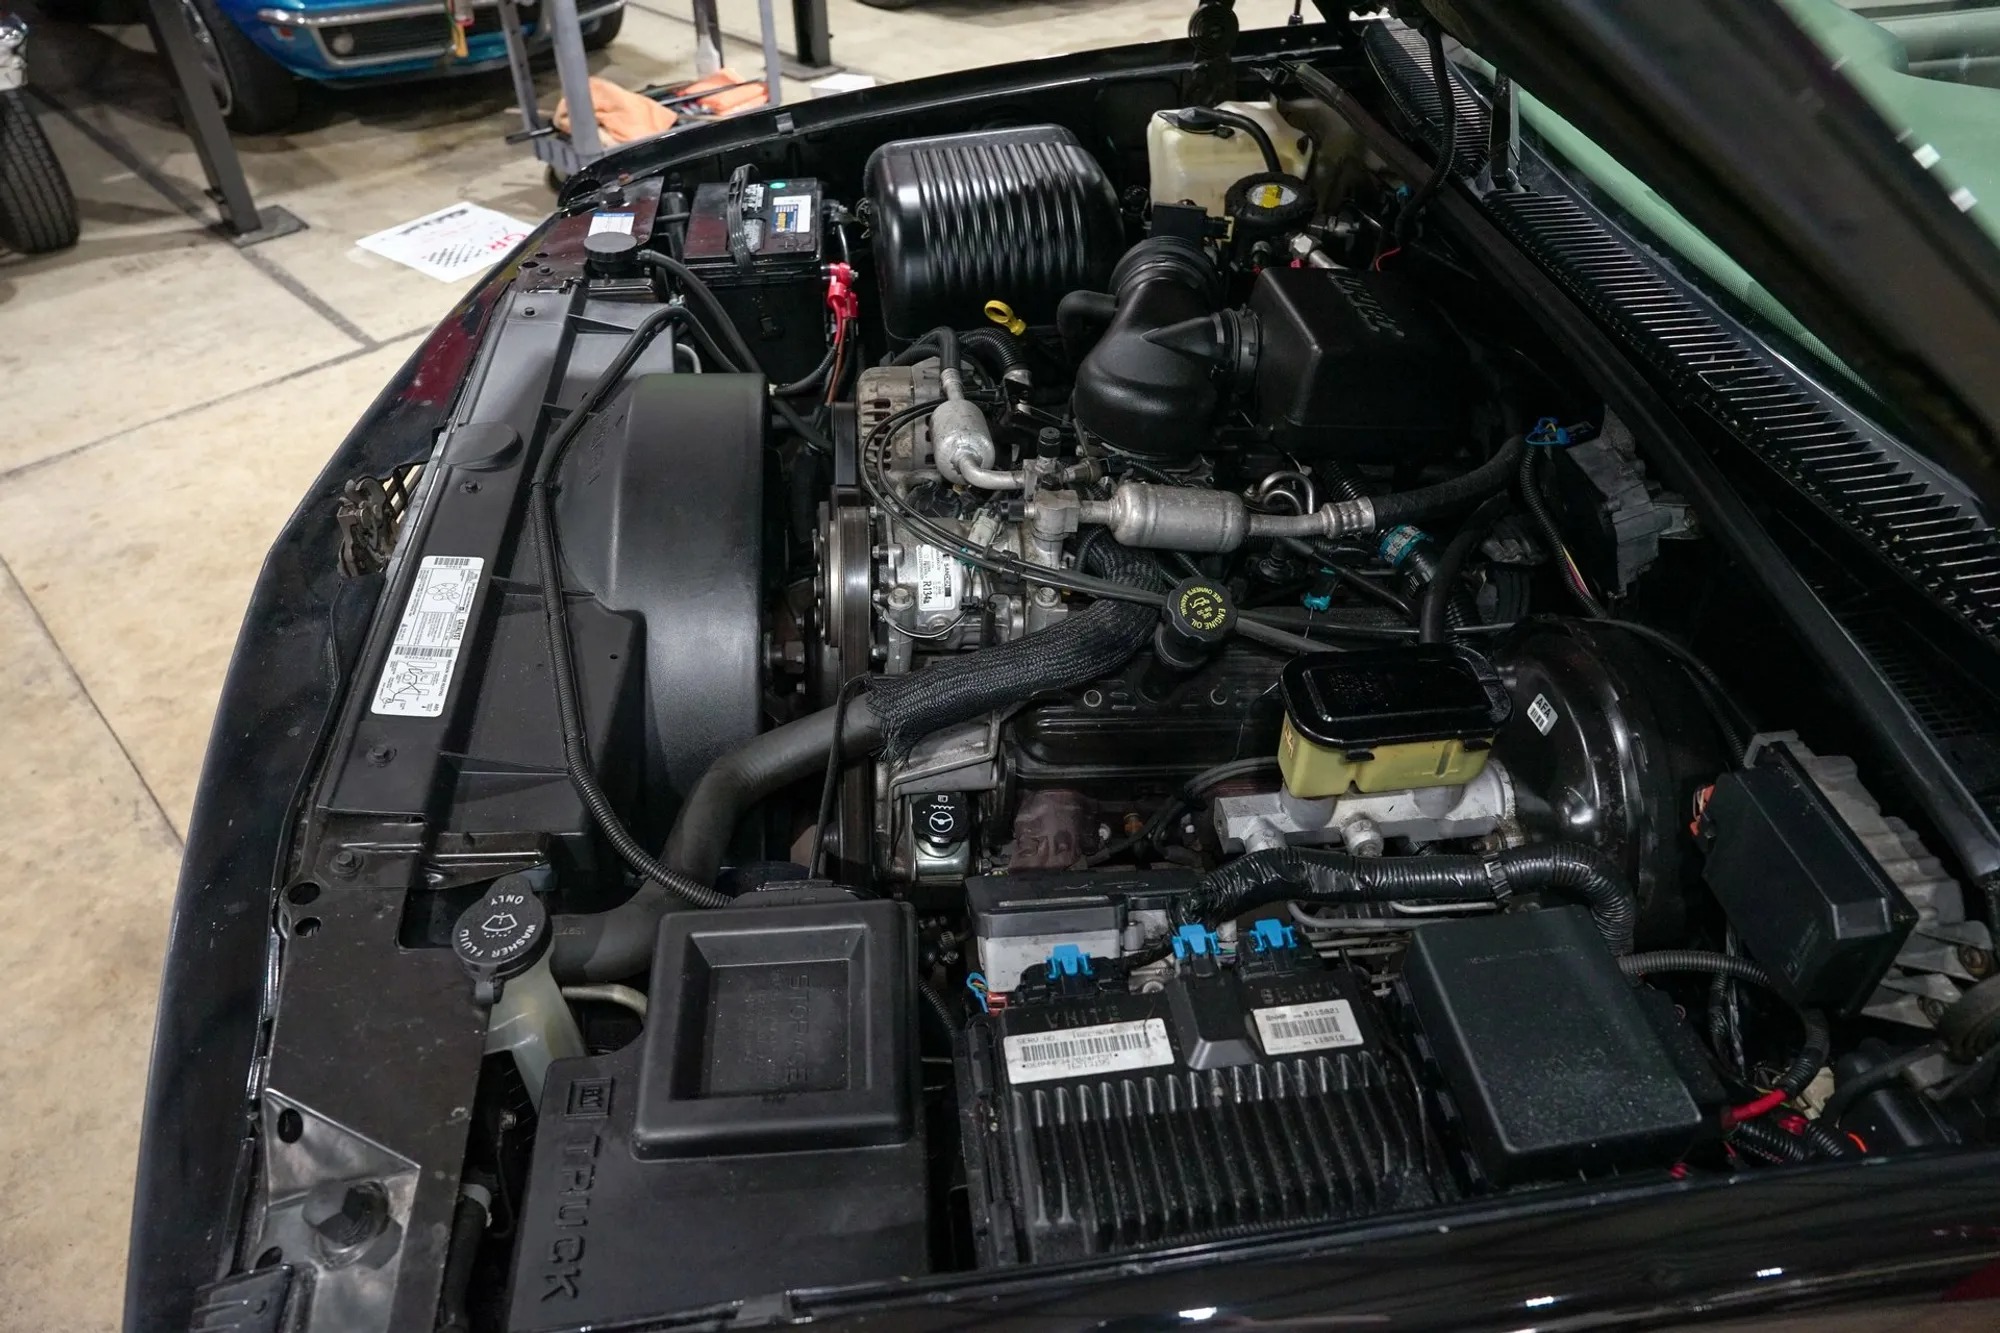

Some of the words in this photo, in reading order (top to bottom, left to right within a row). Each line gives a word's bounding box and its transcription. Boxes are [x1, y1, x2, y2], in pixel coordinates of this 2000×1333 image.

[922, 581, 934, 605] R134a
[453, 618, 466, 642] CATALYST
[1190, 618, 1203, 630] OIL
[1204, 607, 1227, 630] ENGINE
[1535, 697, 1552, 719] AFA
[490, 893, 524, 907] ONLY
[459, 928, 486, 958] FLUID
[491, 923, 537, 959] WASHER
[541, 1134, 602, 1303] TRUCK
